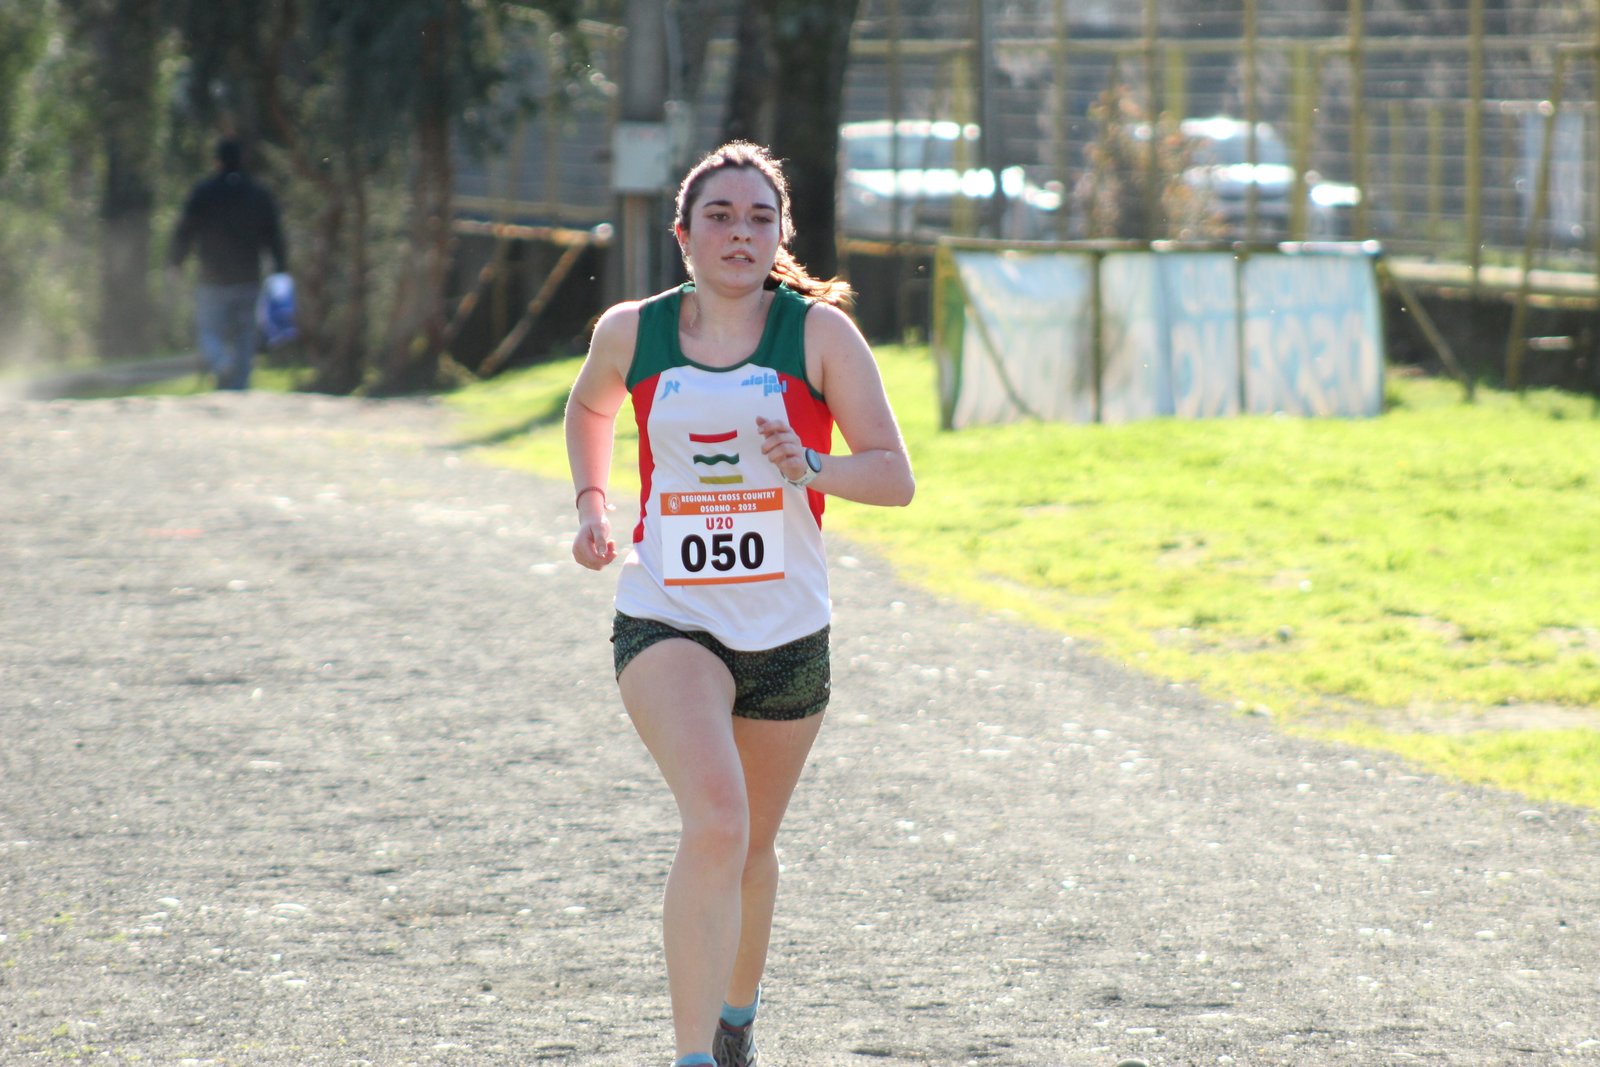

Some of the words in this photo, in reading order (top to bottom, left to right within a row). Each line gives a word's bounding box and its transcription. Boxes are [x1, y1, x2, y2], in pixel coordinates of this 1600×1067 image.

[681, 494, 716, 503] REGIONAL
[718, 493, 740, 501] CROSS
[743, 491, 776, 500] COUNTRY
[700, 505, 731, 513] OSORNO
[738, 503, 757, 511] 2025
[706, 516, 734, 530] U20
[681, 531, 765, 573] 050
